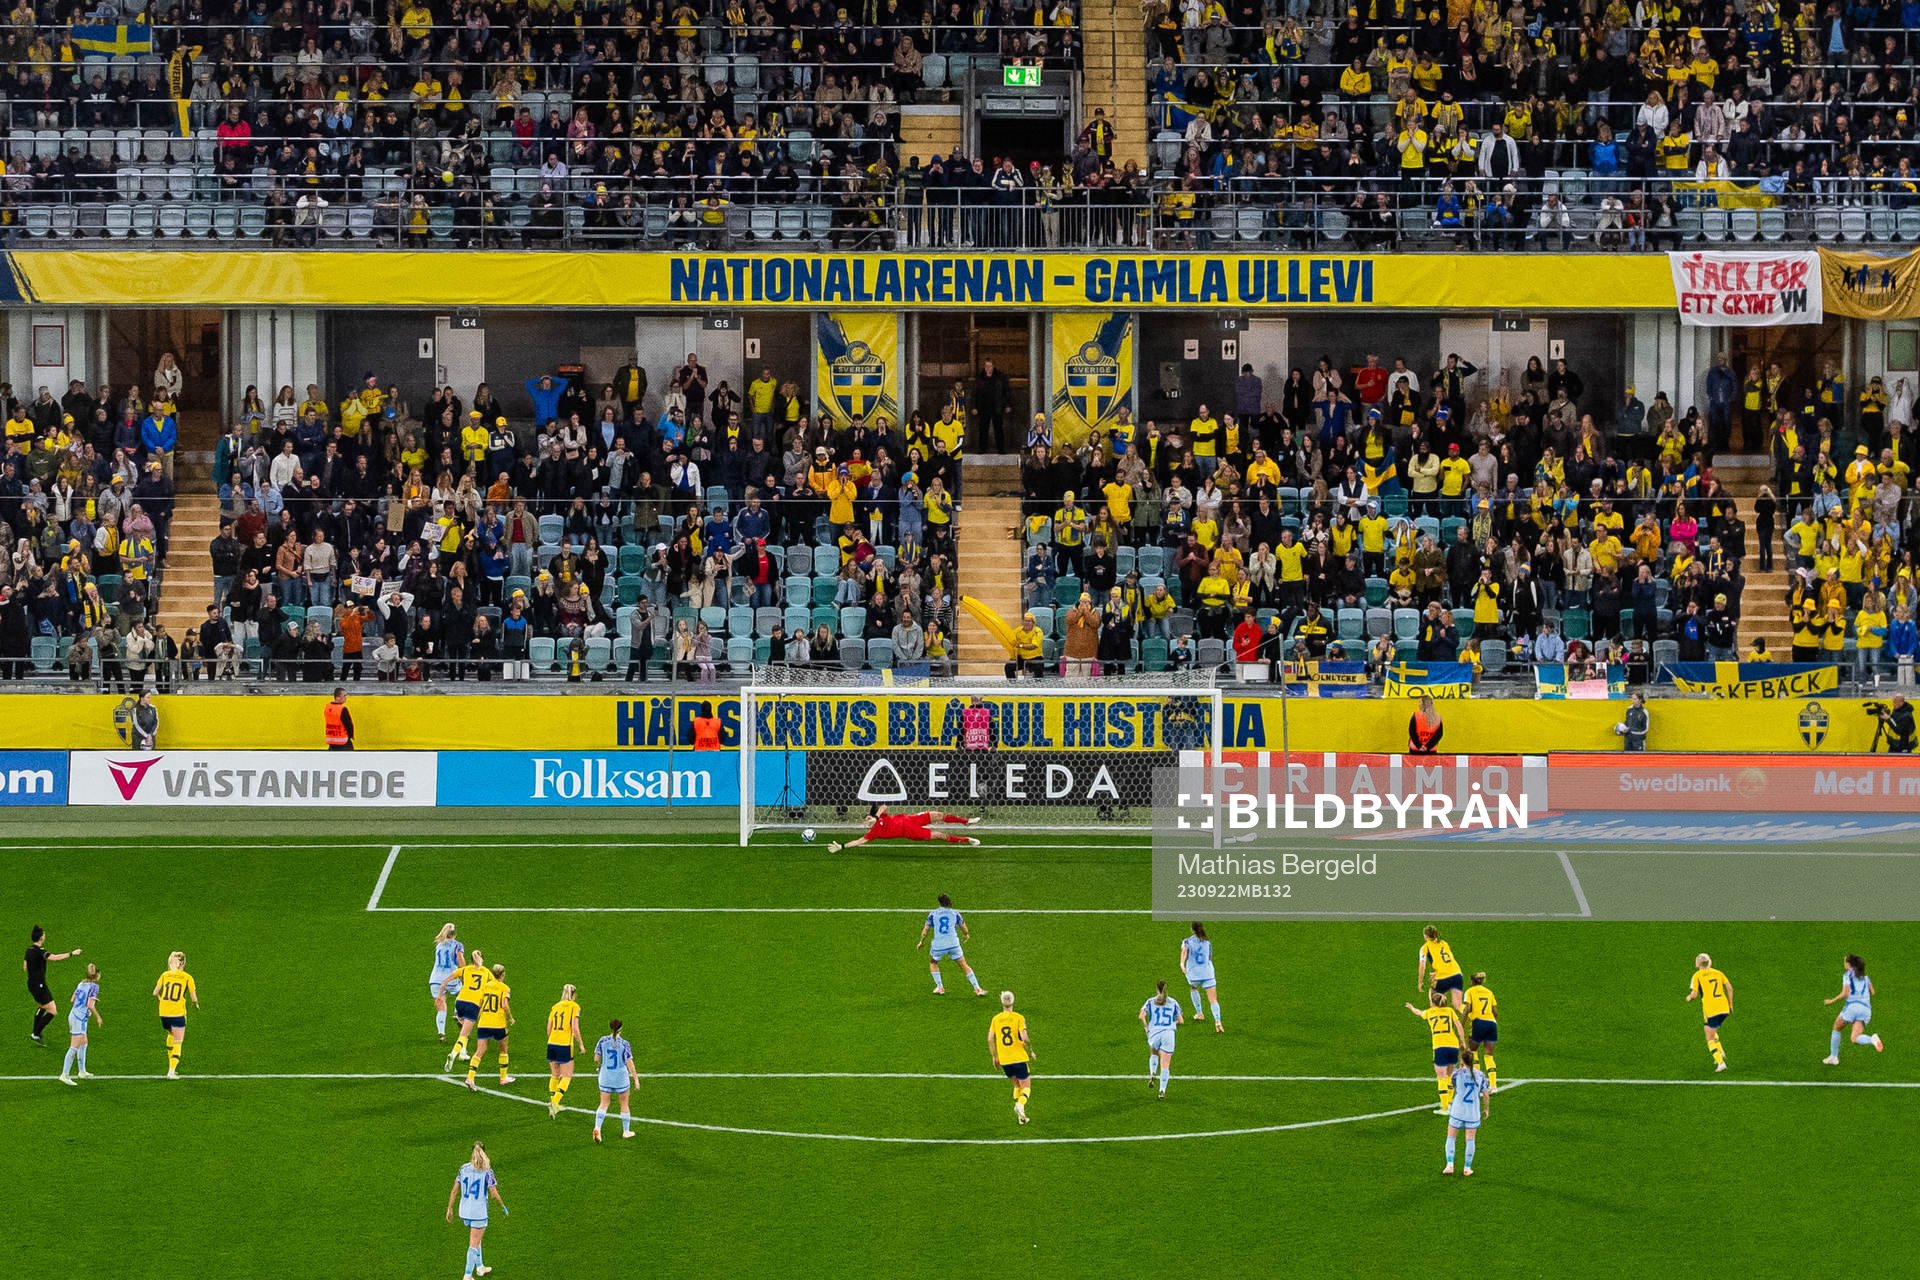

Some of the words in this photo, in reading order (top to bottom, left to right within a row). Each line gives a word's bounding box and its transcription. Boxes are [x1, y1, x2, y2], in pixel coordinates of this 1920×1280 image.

[670, 258, 1044, 302] NATIONALARENAN
[1085, 259, 1229, 303] GAMLA
[1238, 259, 1373, 303] ULLEVI
[1757, 260, 1808, 292] FÖR
[1681, 292, 1717, 314] ETT
[1781, 288, 1807, 313] VM
[461, 318, 477, 327] G4
[714, 319, 729, 328] G5
[1072, 366, 1111, 374] SVERIGE
[717, 700, 877, 747] SKRIVS
[1063, 701, 1266, 748] HISTRIA
[0, 769, 54, 794] m
[162, 762, 405, 798] VÄSTANHEDE
[530, 758, 712, 799] Folksam
[928, 763, 1120, 799] ELEDA
[1618, 773, 1731, 793] Swedbank
[1814, 771, 1873, 795] Med
[939, 915, 950, 934] 8
[437, 949, 452, 969] 11
[1439, 947, 1452, 963] 6
[163, 982, 183, 1002] 10
[469, 974, 482, 991] 3
[1709, 978, 1722, 998] 2
[482, 993, 499, 1013] 20
[1478, 997, 1489, 1015] 7
[554, 1011, 565, 1031] 11
[1154, 1007, 1173, 1027] 15
[1430, 1015, 1451, 1034] 23
[1001, 1026, 1014, 1047] 8
[606, 1049, 618, 1070] 3
[1463, 1082, 1475, 1104] 2
[462, 1176, 482, 1200] 14
